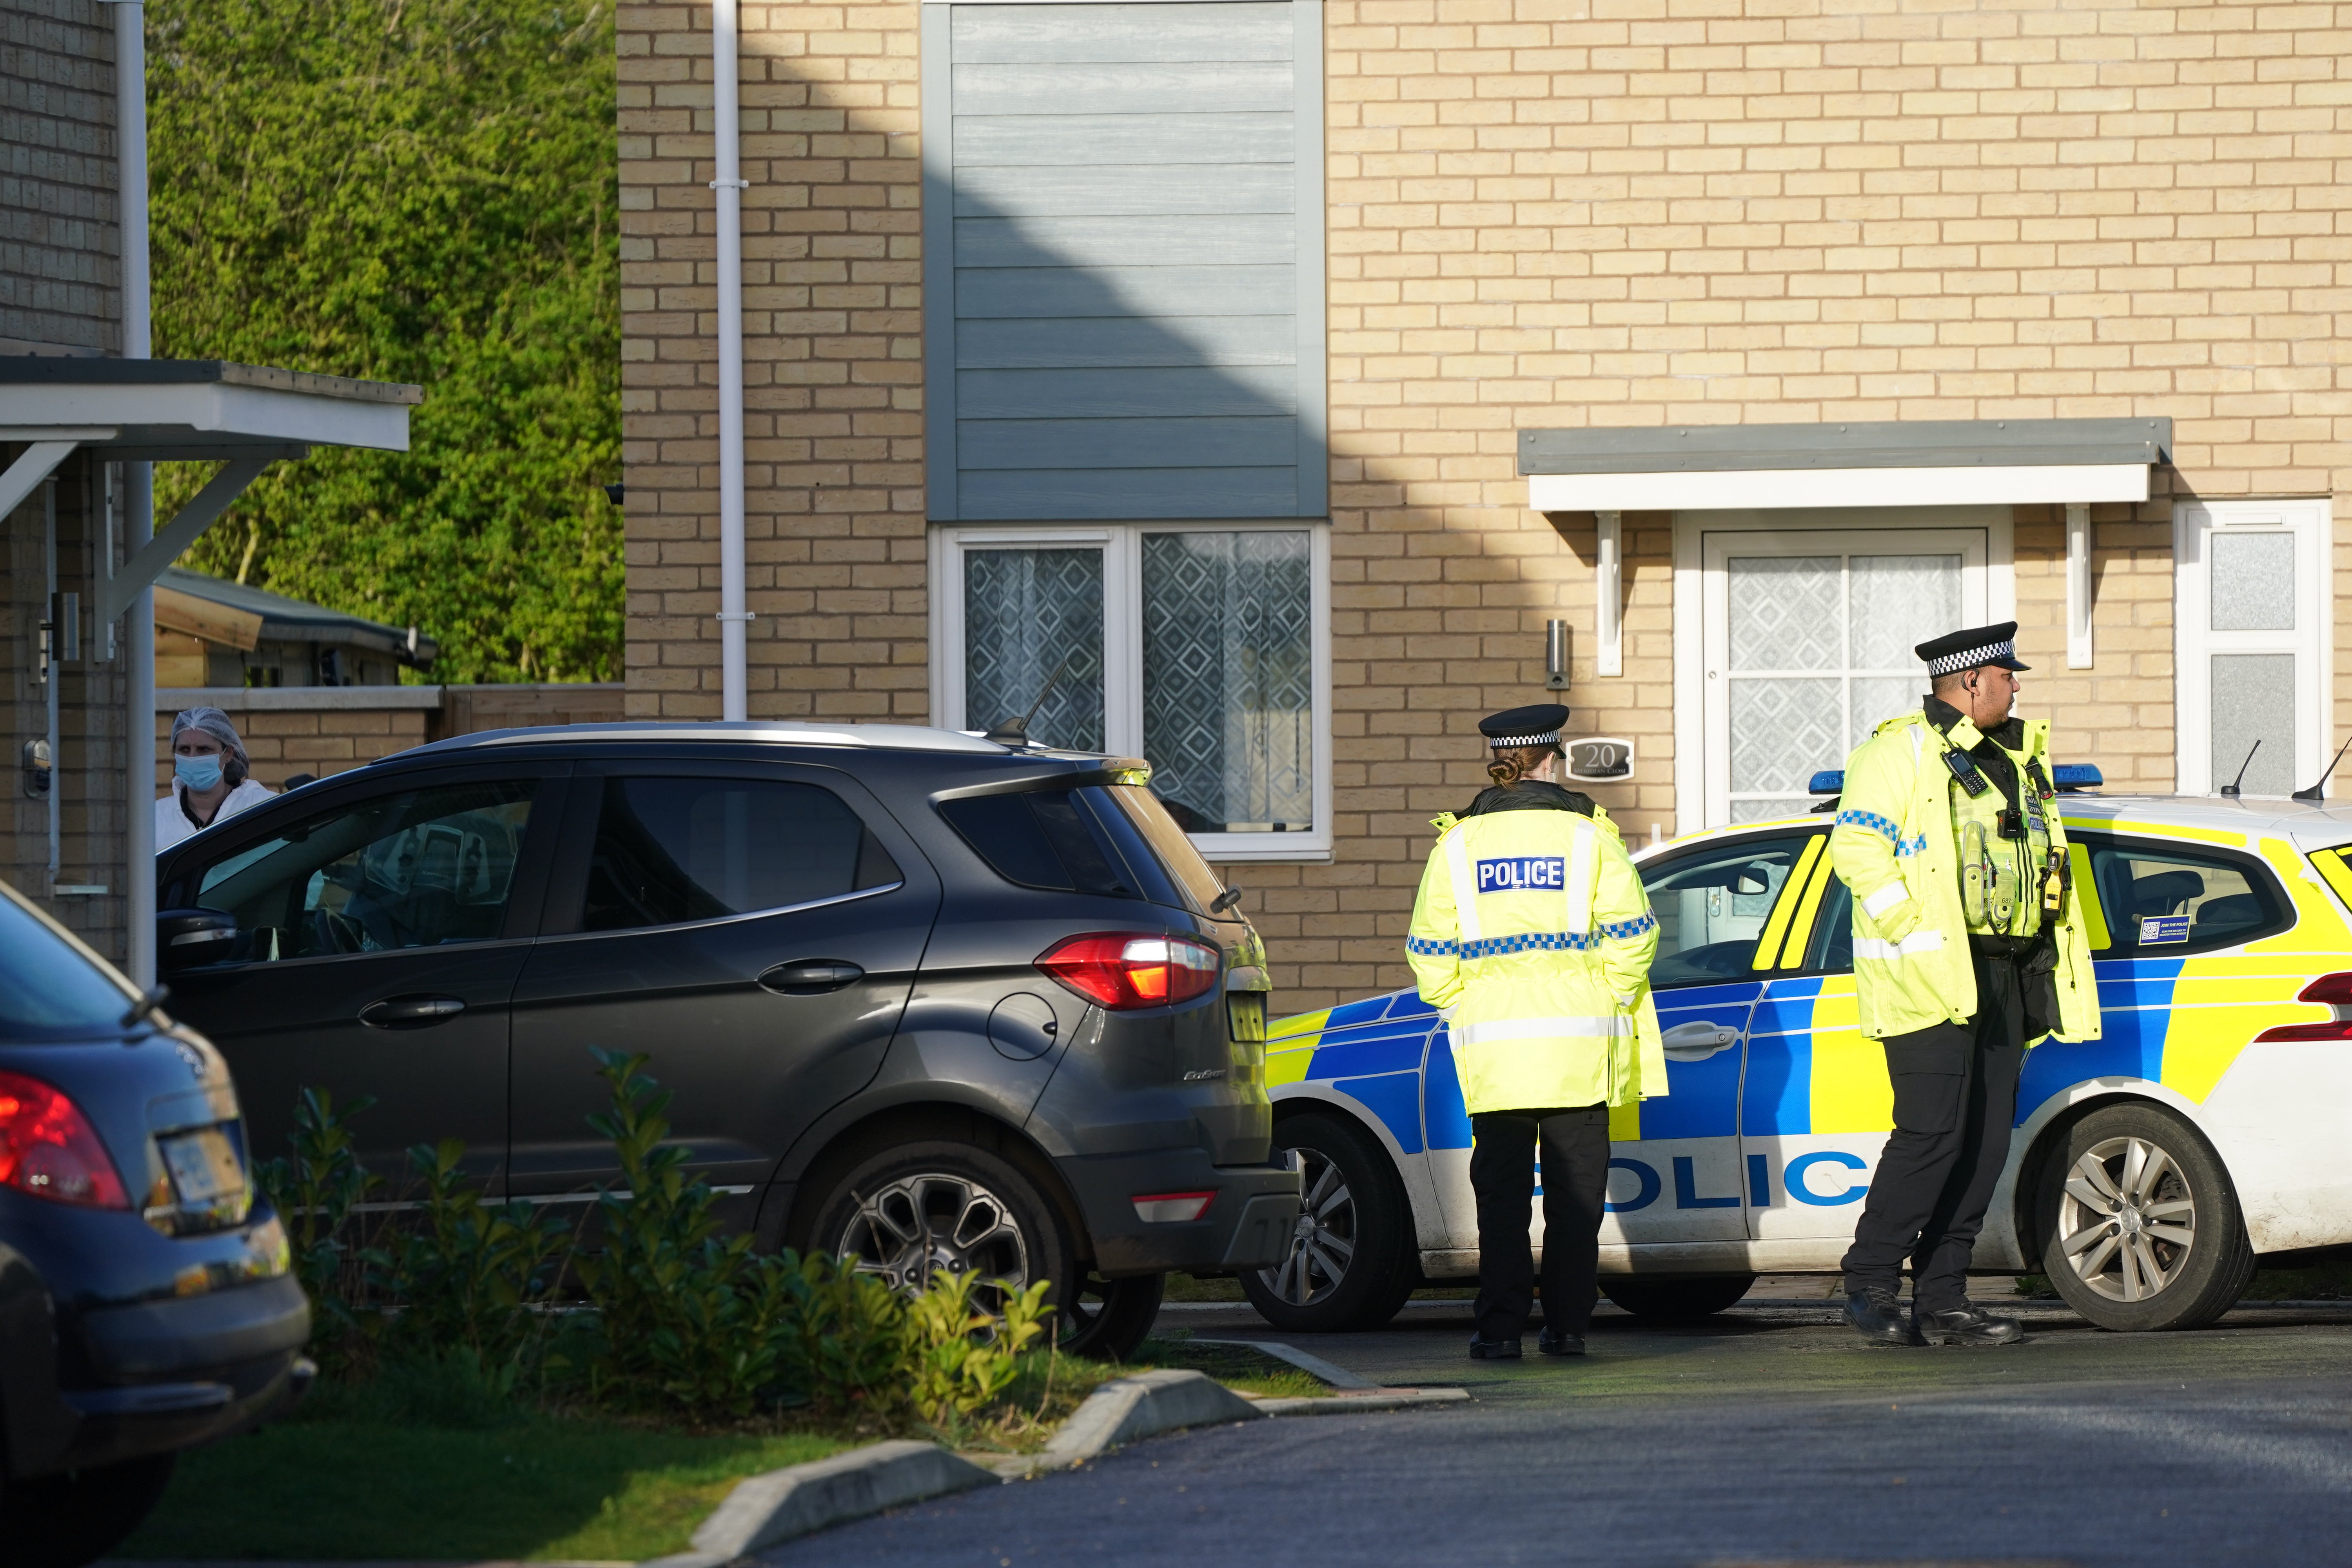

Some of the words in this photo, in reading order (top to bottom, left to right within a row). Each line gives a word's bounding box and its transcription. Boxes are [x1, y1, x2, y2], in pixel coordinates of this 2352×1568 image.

[1585, 744, 1615, 768] 20
[1480, 861, 1561, 888] POLICE
[1532, 1151, 1869, 1213] OLIC
